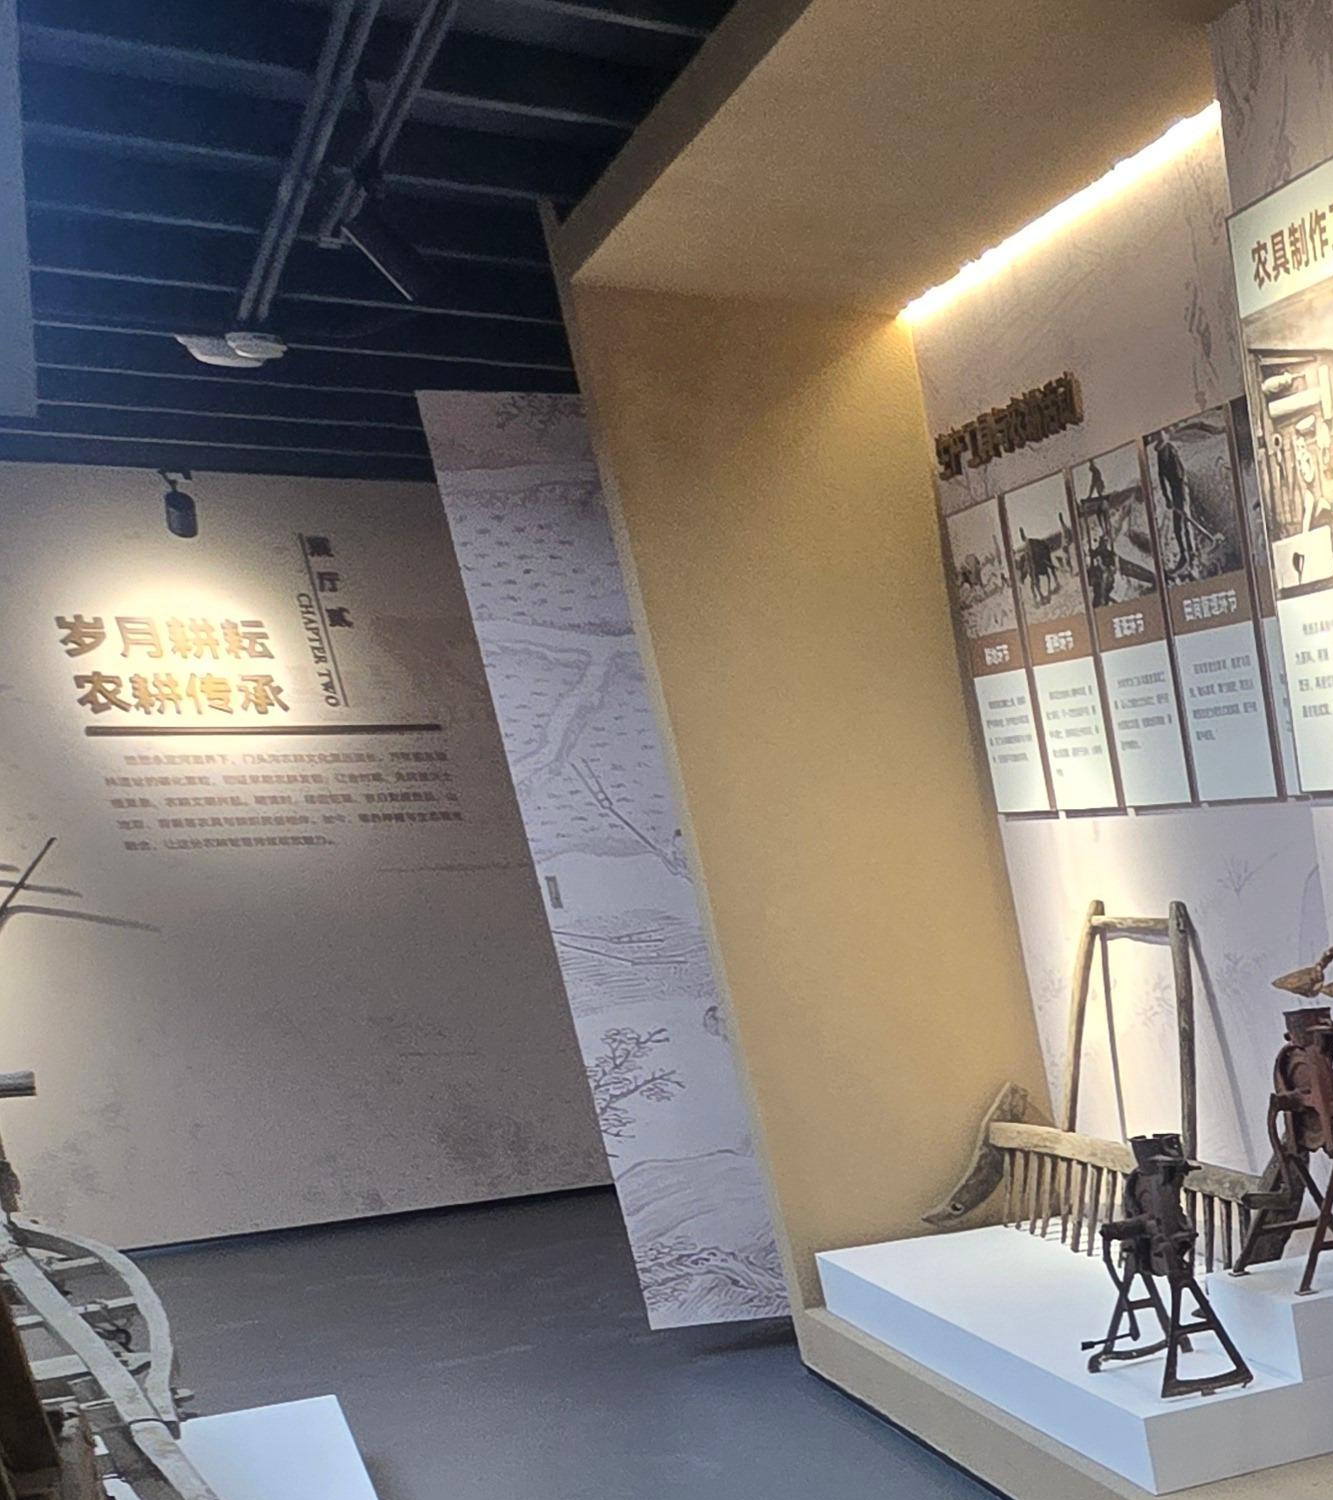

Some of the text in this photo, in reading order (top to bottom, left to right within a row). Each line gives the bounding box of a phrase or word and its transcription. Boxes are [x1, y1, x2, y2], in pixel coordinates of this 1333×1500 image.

[55, 614, 274, 659] 岁月耕耘
[296, 592, 341, 708] CHAPTER TWO
[74, 671, 290, 714] 农耕传承
